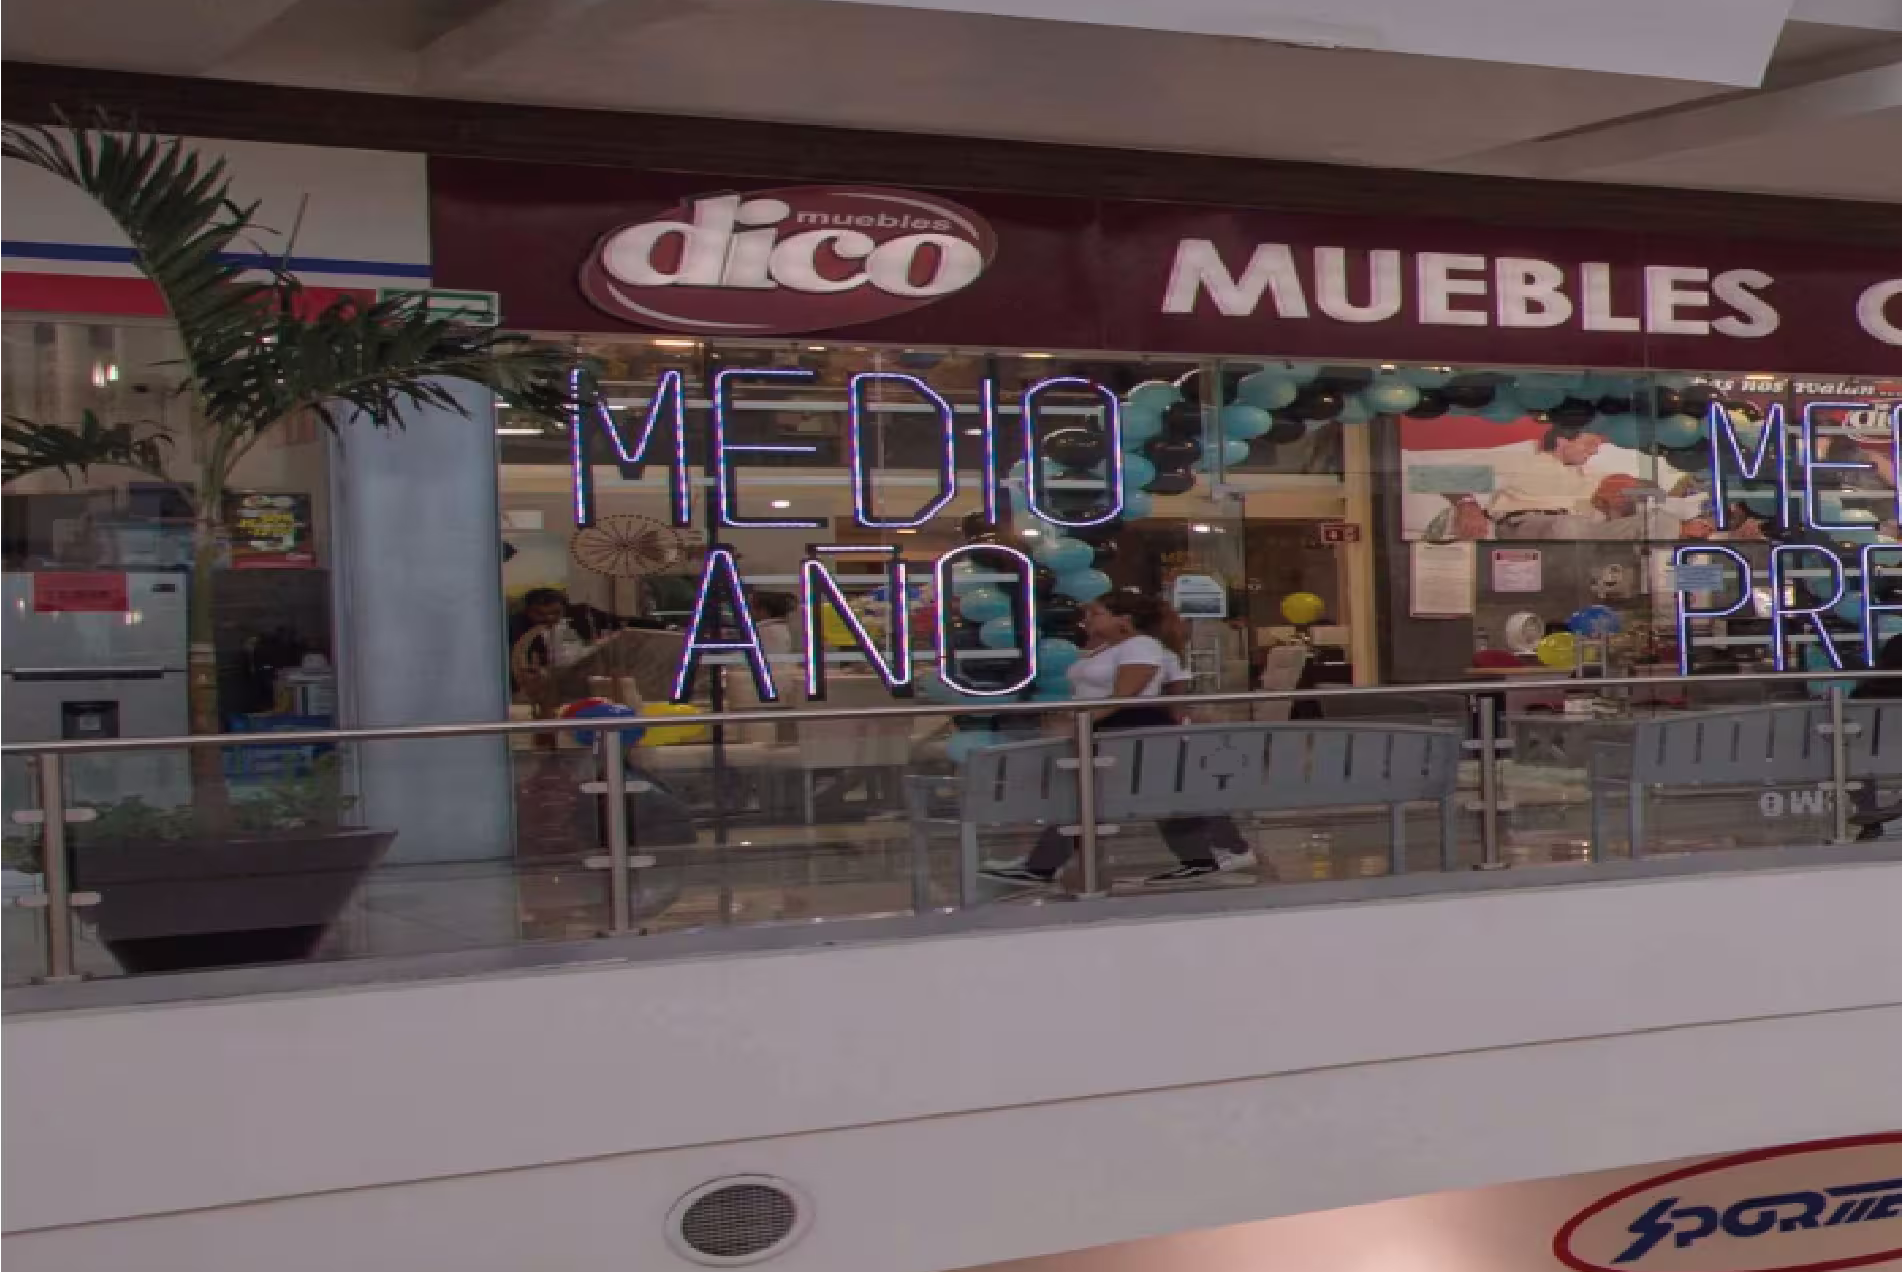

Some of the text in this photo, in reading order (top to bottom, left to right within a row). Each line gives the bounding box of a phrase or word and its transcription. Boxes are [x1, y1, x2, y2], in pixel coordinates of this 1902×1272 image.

[603, 194, 982, 296] dico
[796, 211, 955, 232] muebles
[1162, 238, 1780, 337] MUEBLES
[570, 367, 1125, 528] MEDIO
[671, 543, 1039, 701] AÑO
